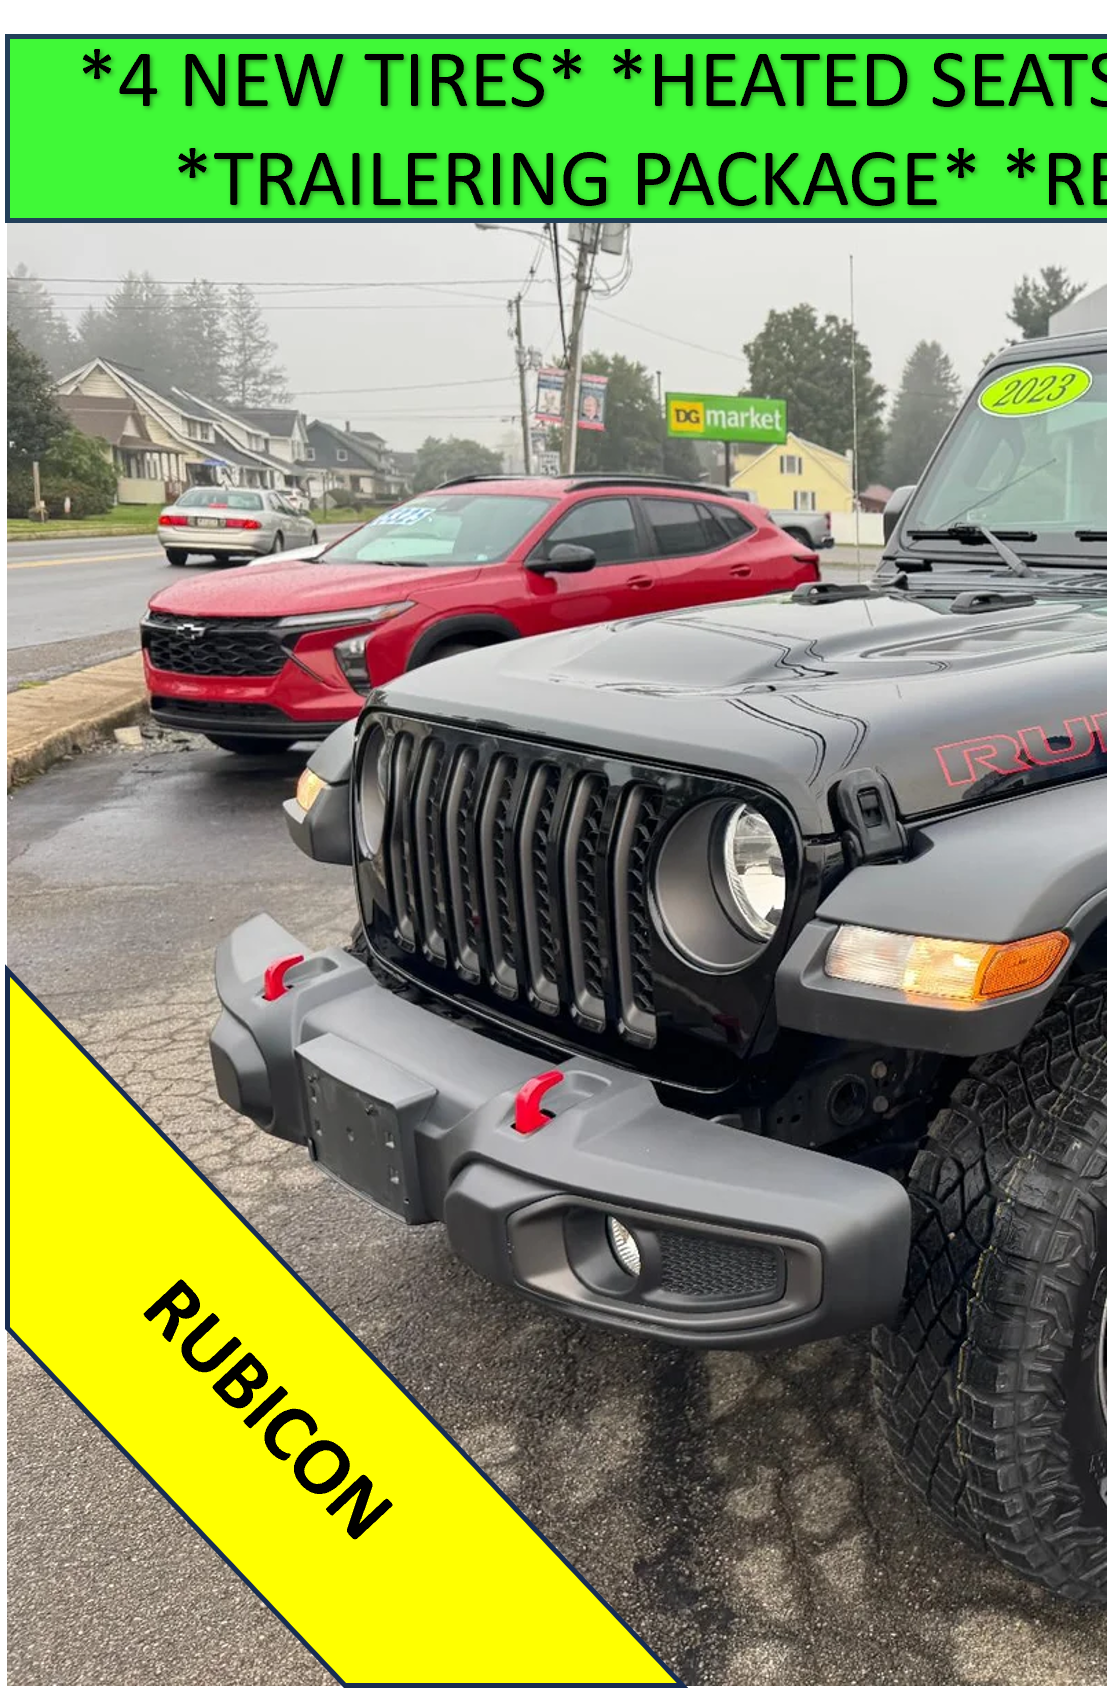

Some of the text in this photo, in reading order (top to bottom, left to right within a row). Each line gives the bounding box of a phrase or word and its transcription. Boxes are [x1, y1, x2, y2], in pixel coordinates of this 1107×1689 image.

[992, 373, 1077, 407] 2023
[674, 405, 784, 431] DG market
